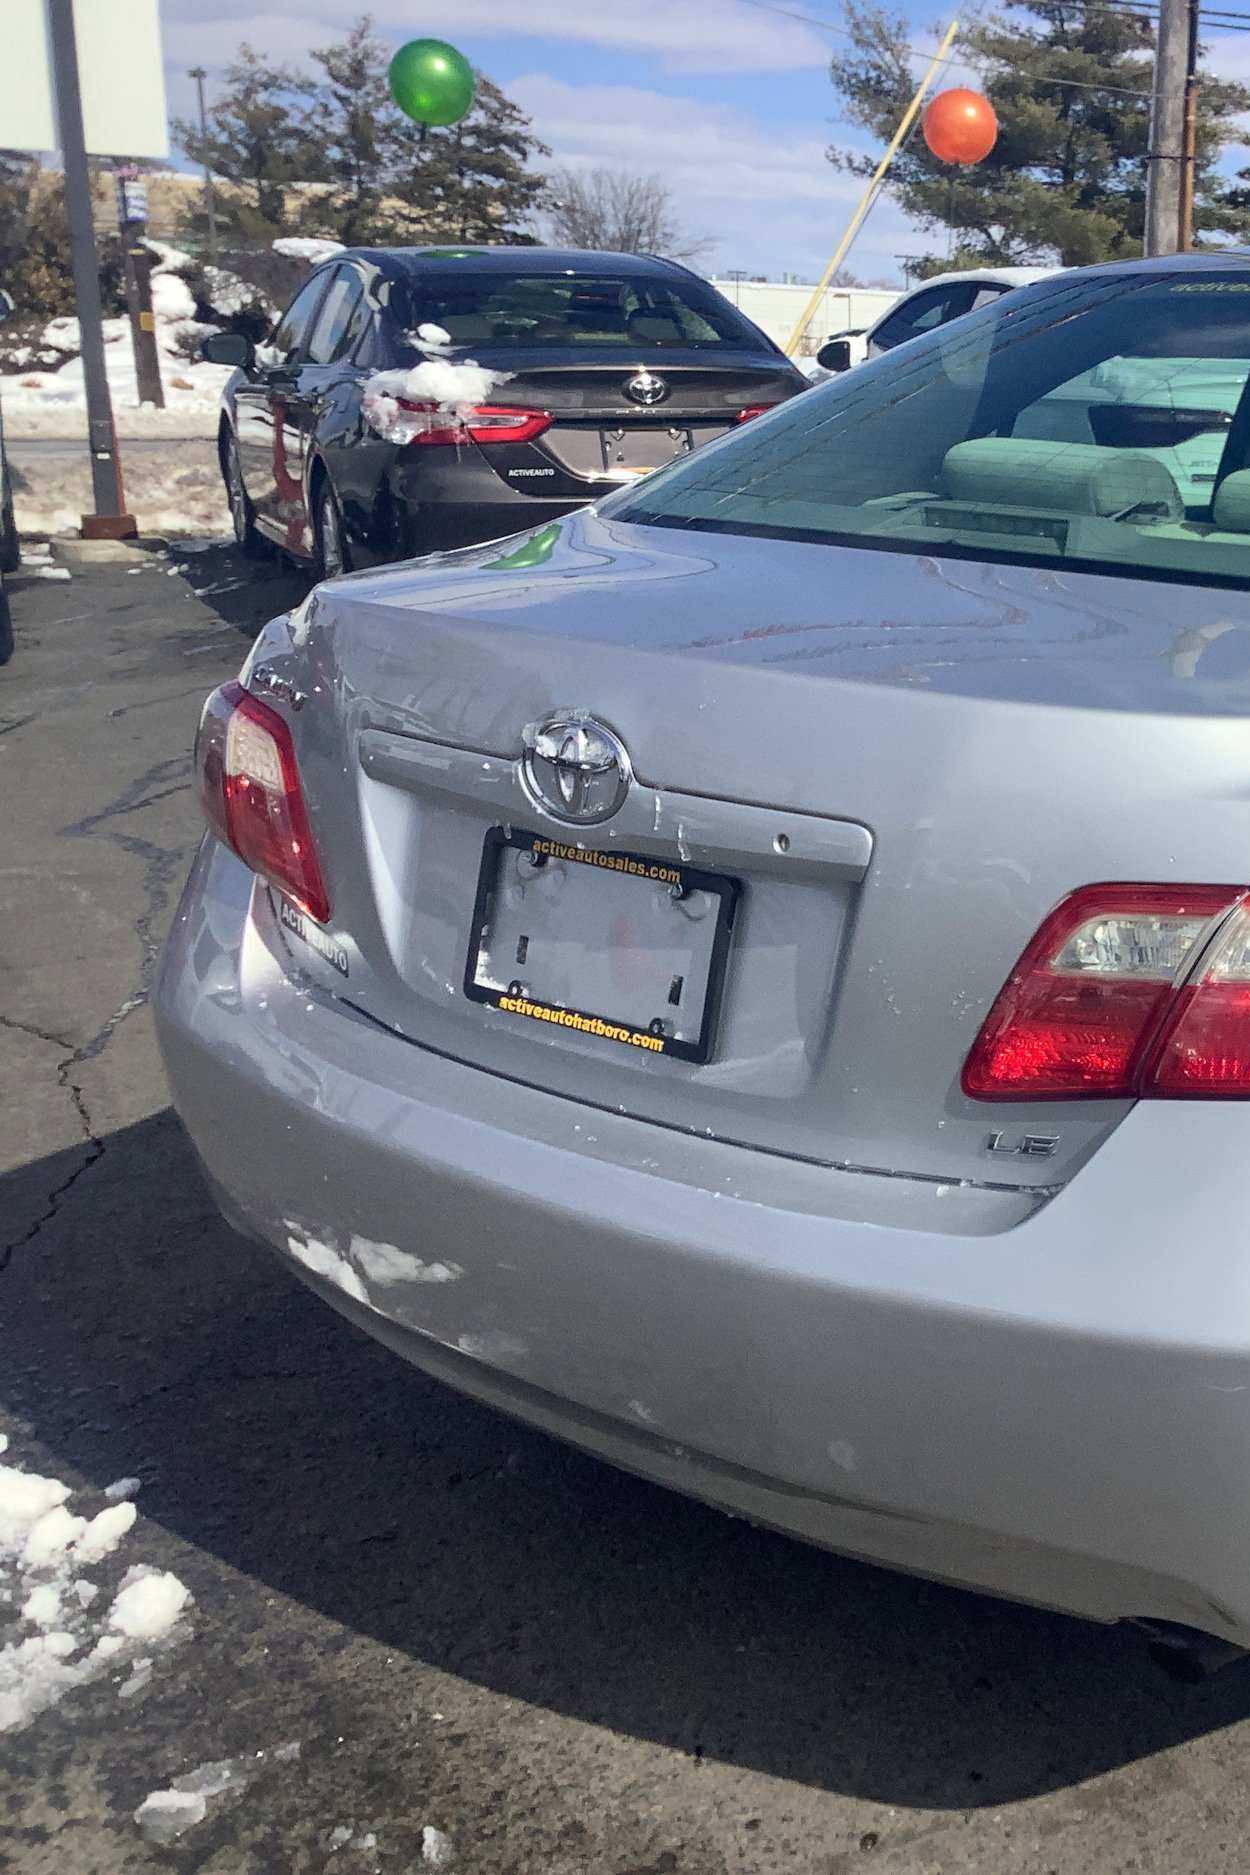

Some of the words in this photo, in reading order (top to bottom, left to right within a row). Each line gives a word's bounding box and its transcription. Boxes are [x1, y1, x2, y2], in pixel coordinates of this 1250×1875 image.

[508, 468, 555, 477] ACTIVEAUTO
[532, 838, 681, 883] activeautosales.com
[499, 996, 665, 1052] activeautohatboro.com
[987, 1130, 1060, 1156] LE
